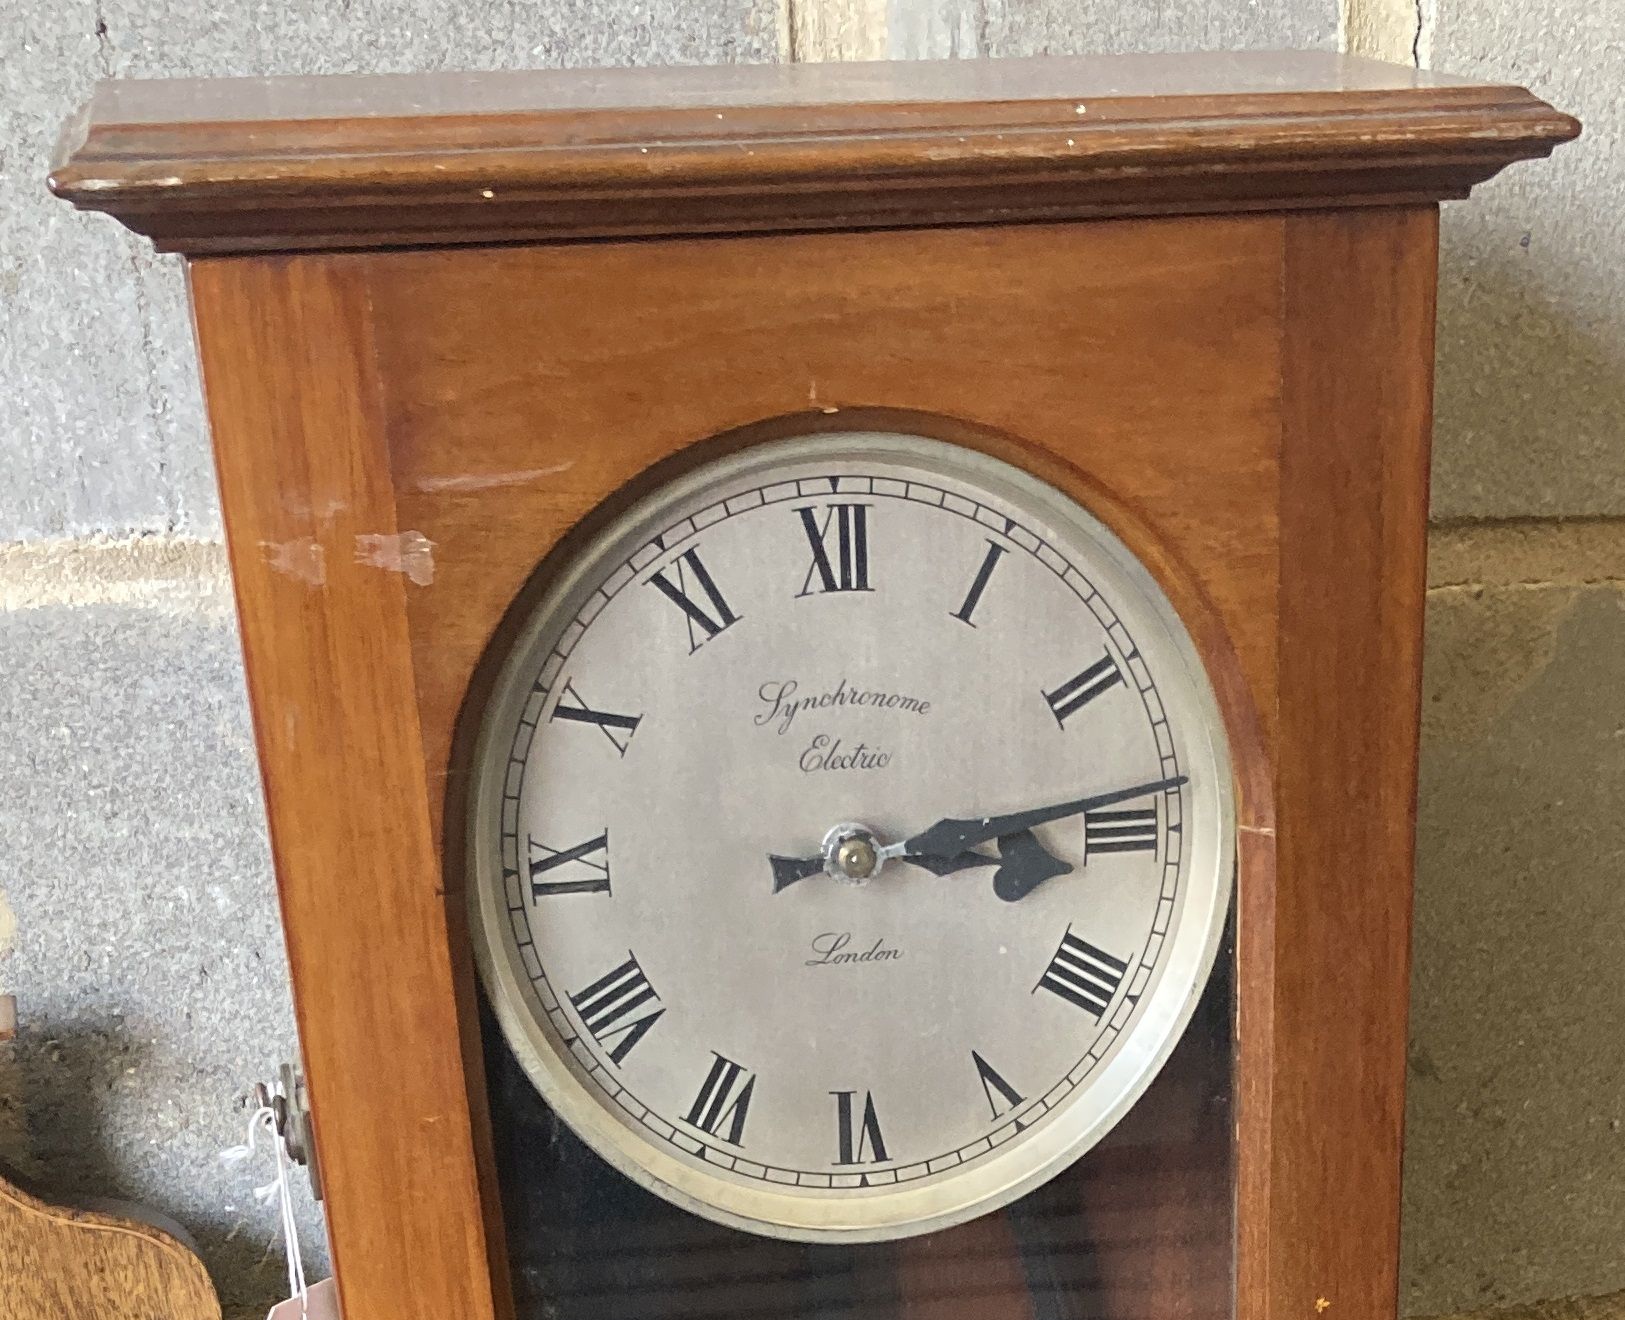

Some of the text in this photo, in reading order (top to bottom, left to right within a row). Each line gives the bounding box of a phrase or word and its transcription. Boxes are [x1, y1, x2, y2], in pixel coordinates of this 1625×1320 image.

[793, 504, 875, 597] XII
[950, 539, 1009, 629] I
[644, 544, 743, 655] XI
[550, 677, 643, 757] X
[754, 679, 931, 735] Synchronome
[1041, 645, 1128, 730] II
[799, 734, 892, 773] Electric
[528, 828, 612, 907] IX
[1084, 795, 1159, 864] III
[805, 932, 904, 966] London
[1032, 923, 1134, 1026] IIII
[565, 949, 667, 1070] VIII
[679, 1050, 756, 1149] VII
[972, 1050, 1027, 1122] V
[829, 1090, 893, 1166] VI
